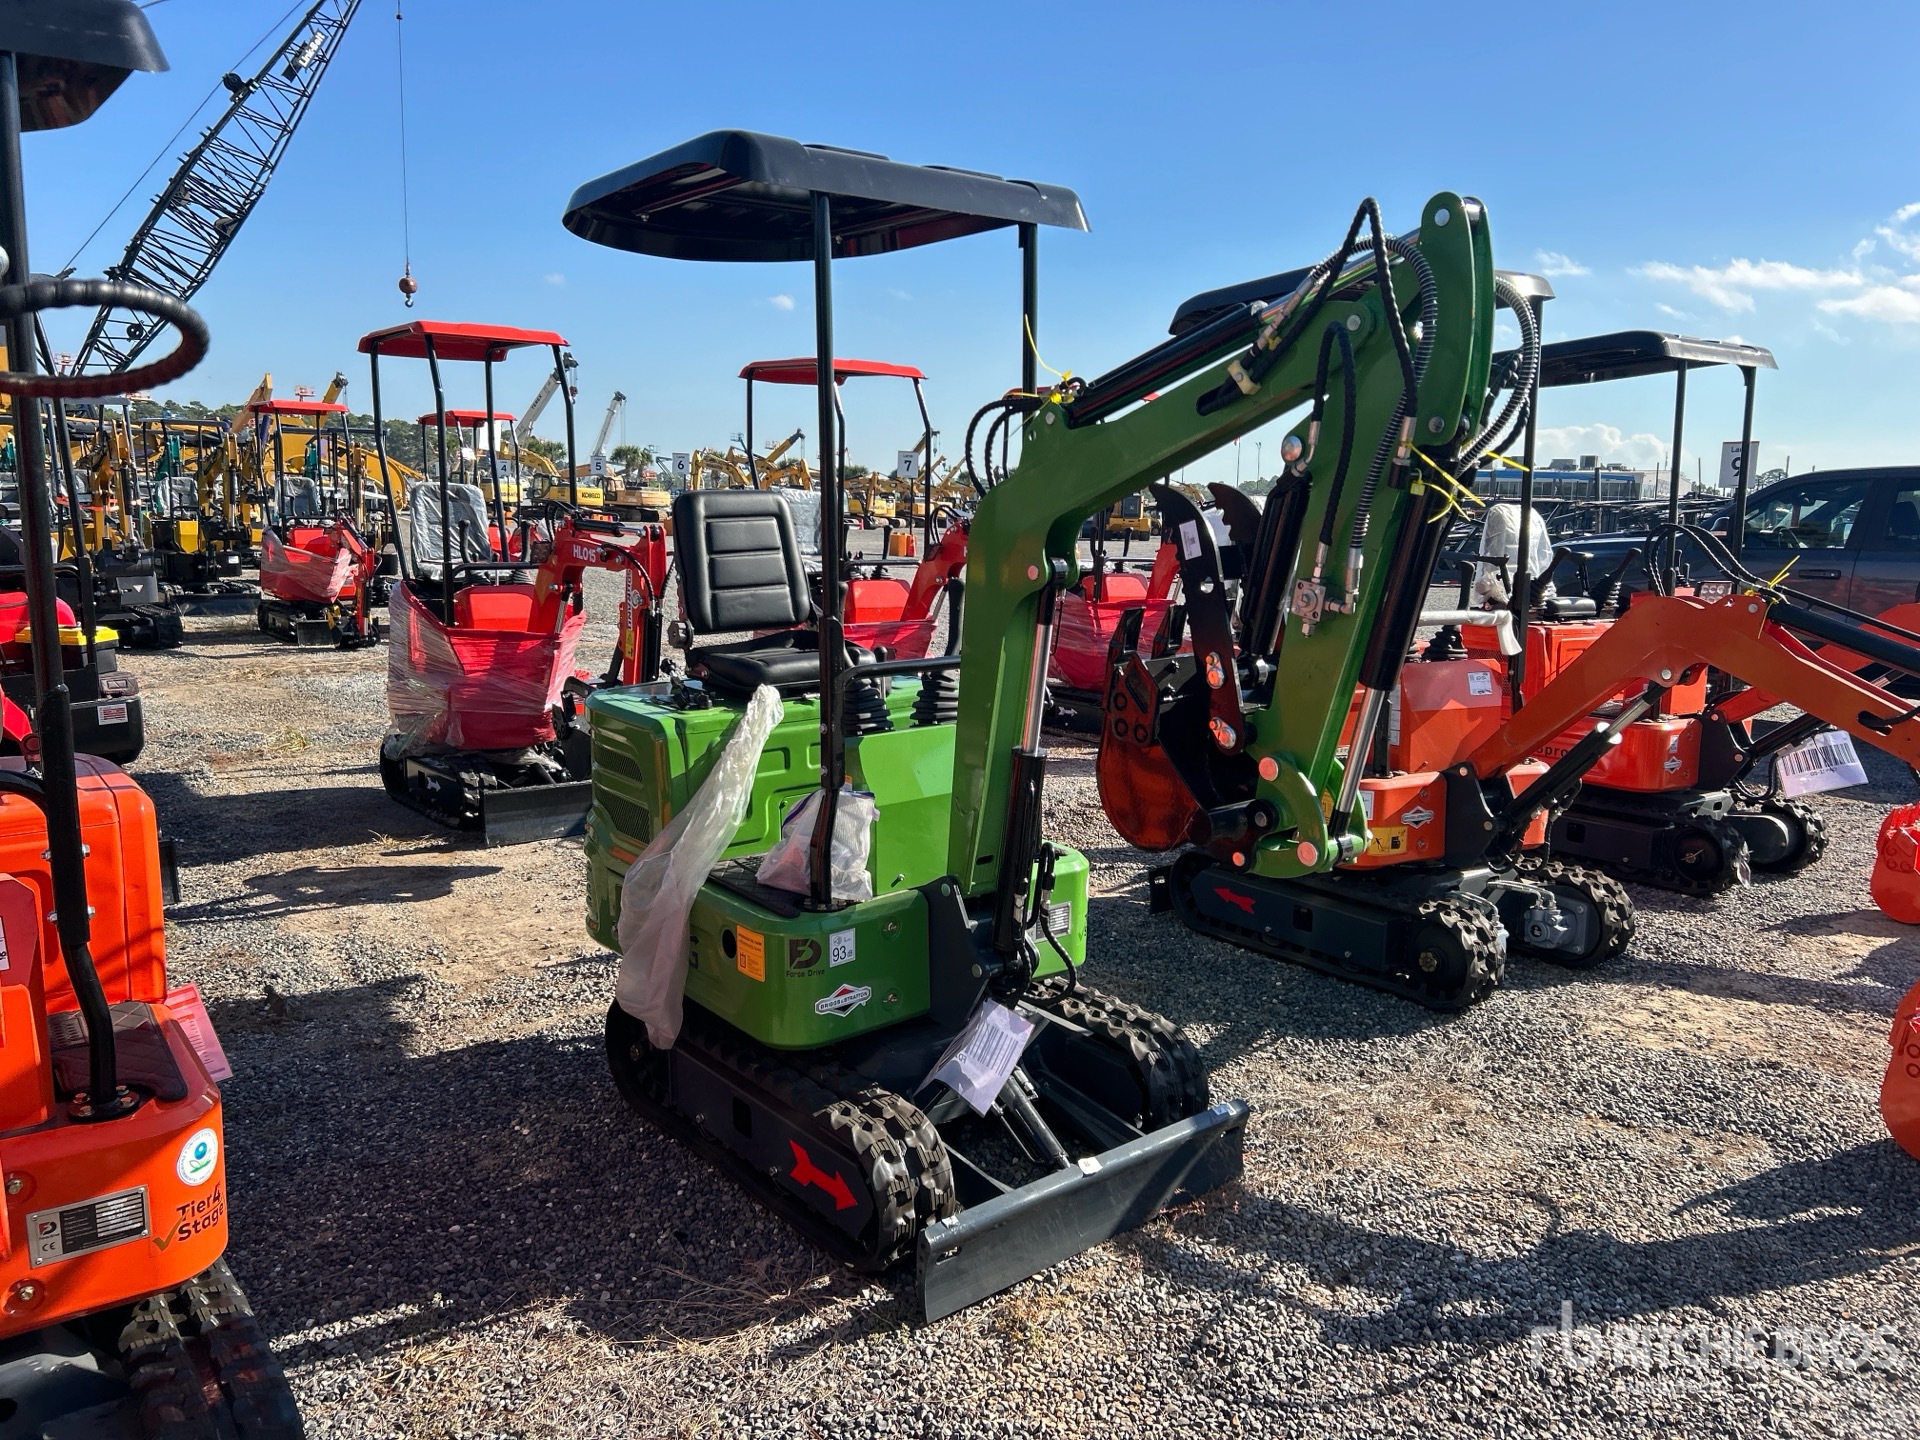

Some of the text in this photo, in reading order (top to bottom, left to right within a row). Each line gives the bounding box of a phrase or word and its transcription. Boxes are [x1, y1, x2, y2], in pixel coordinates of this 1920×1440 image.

[501, 464, 507, 472] 4
[595, 462, 602, 471] 5
[677, 460, 685, 470] 6
[904, 460, 912, 472] 7
[832, 945, 847, 963] 93
